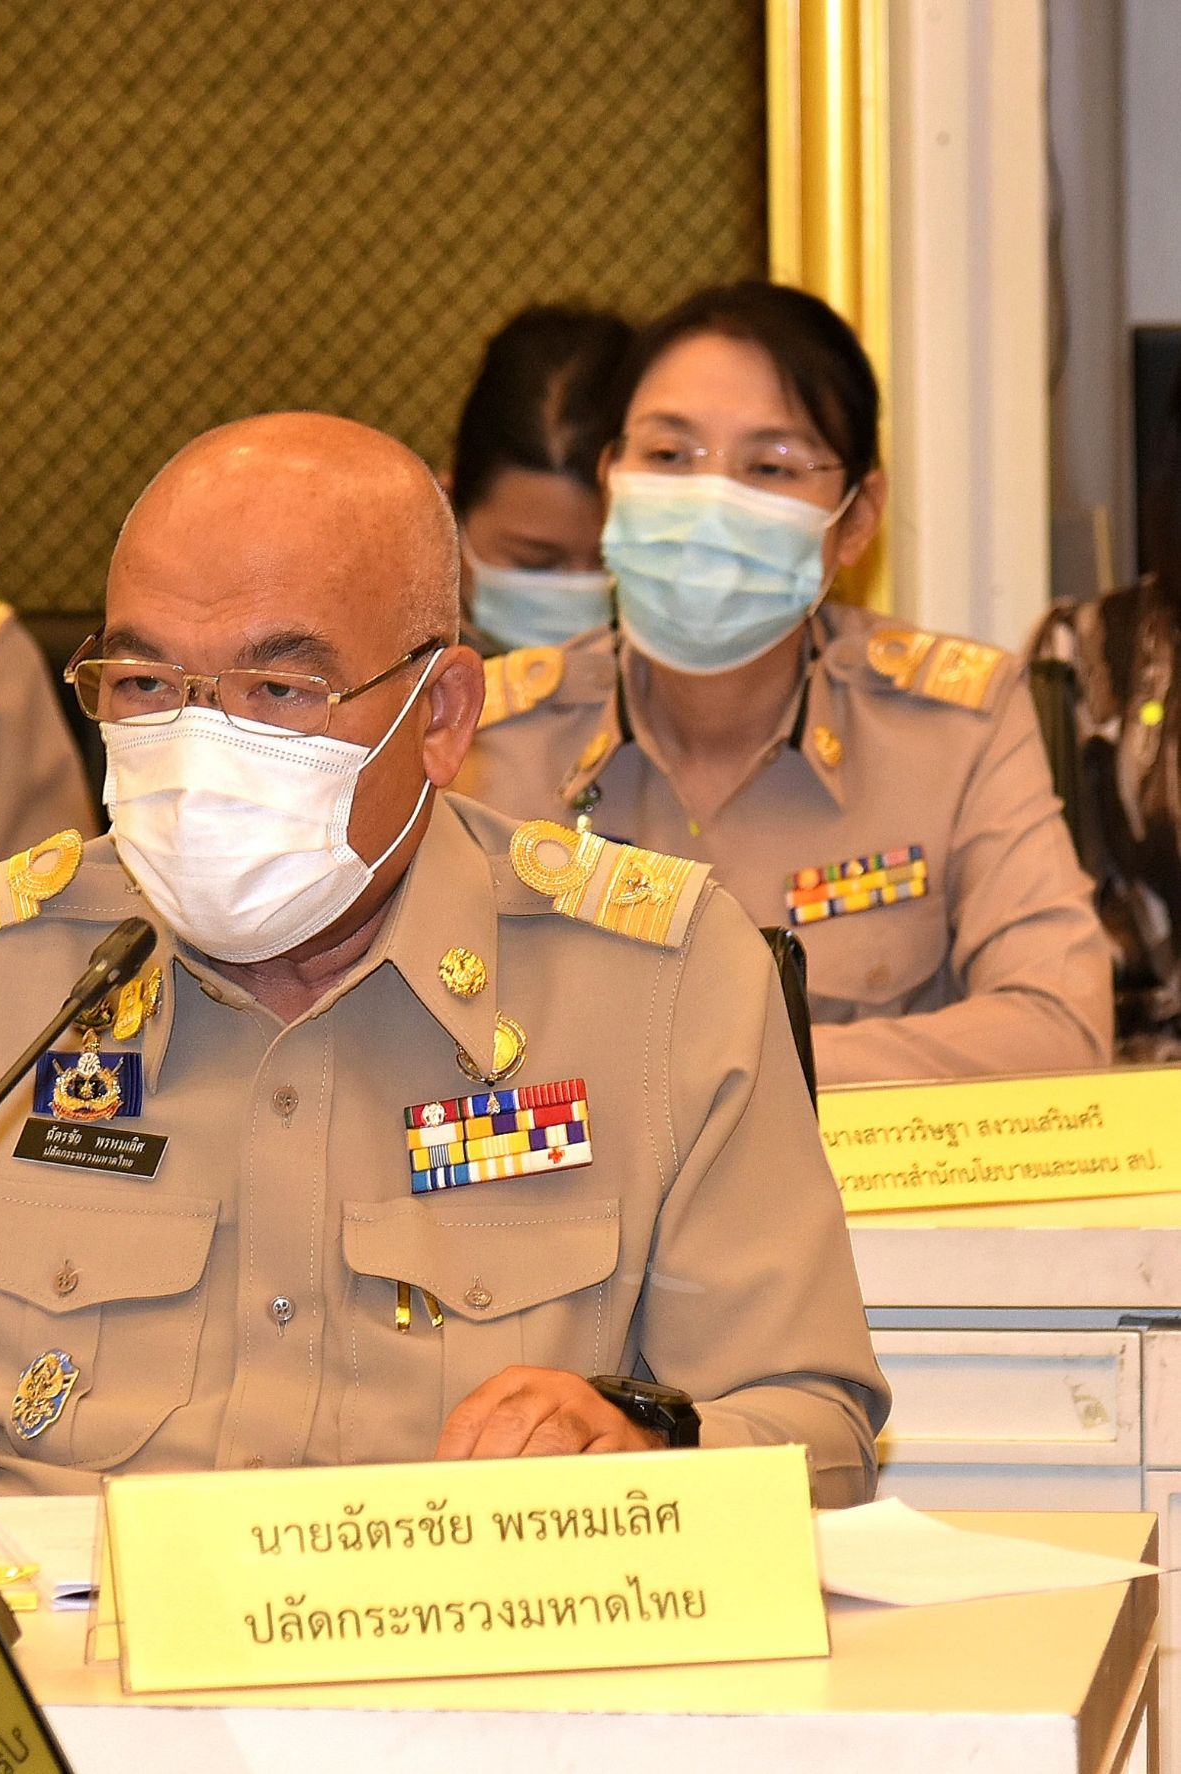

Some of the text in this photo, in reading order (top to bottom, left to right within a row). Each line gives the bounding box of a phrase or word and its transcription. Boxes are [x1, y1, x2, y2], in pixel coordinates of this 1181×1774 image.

[45, 1125, 83, 1145] ฉัตรชัย
[977, 1103, 1105, 1137] สงวนเสริมศรี
[249, 1489, 683, 1557] นายฉัตรชัย พรหมเลิศ
[243, 1575, 708, 1646] ปลัดกระทรวงมหาดไทย
